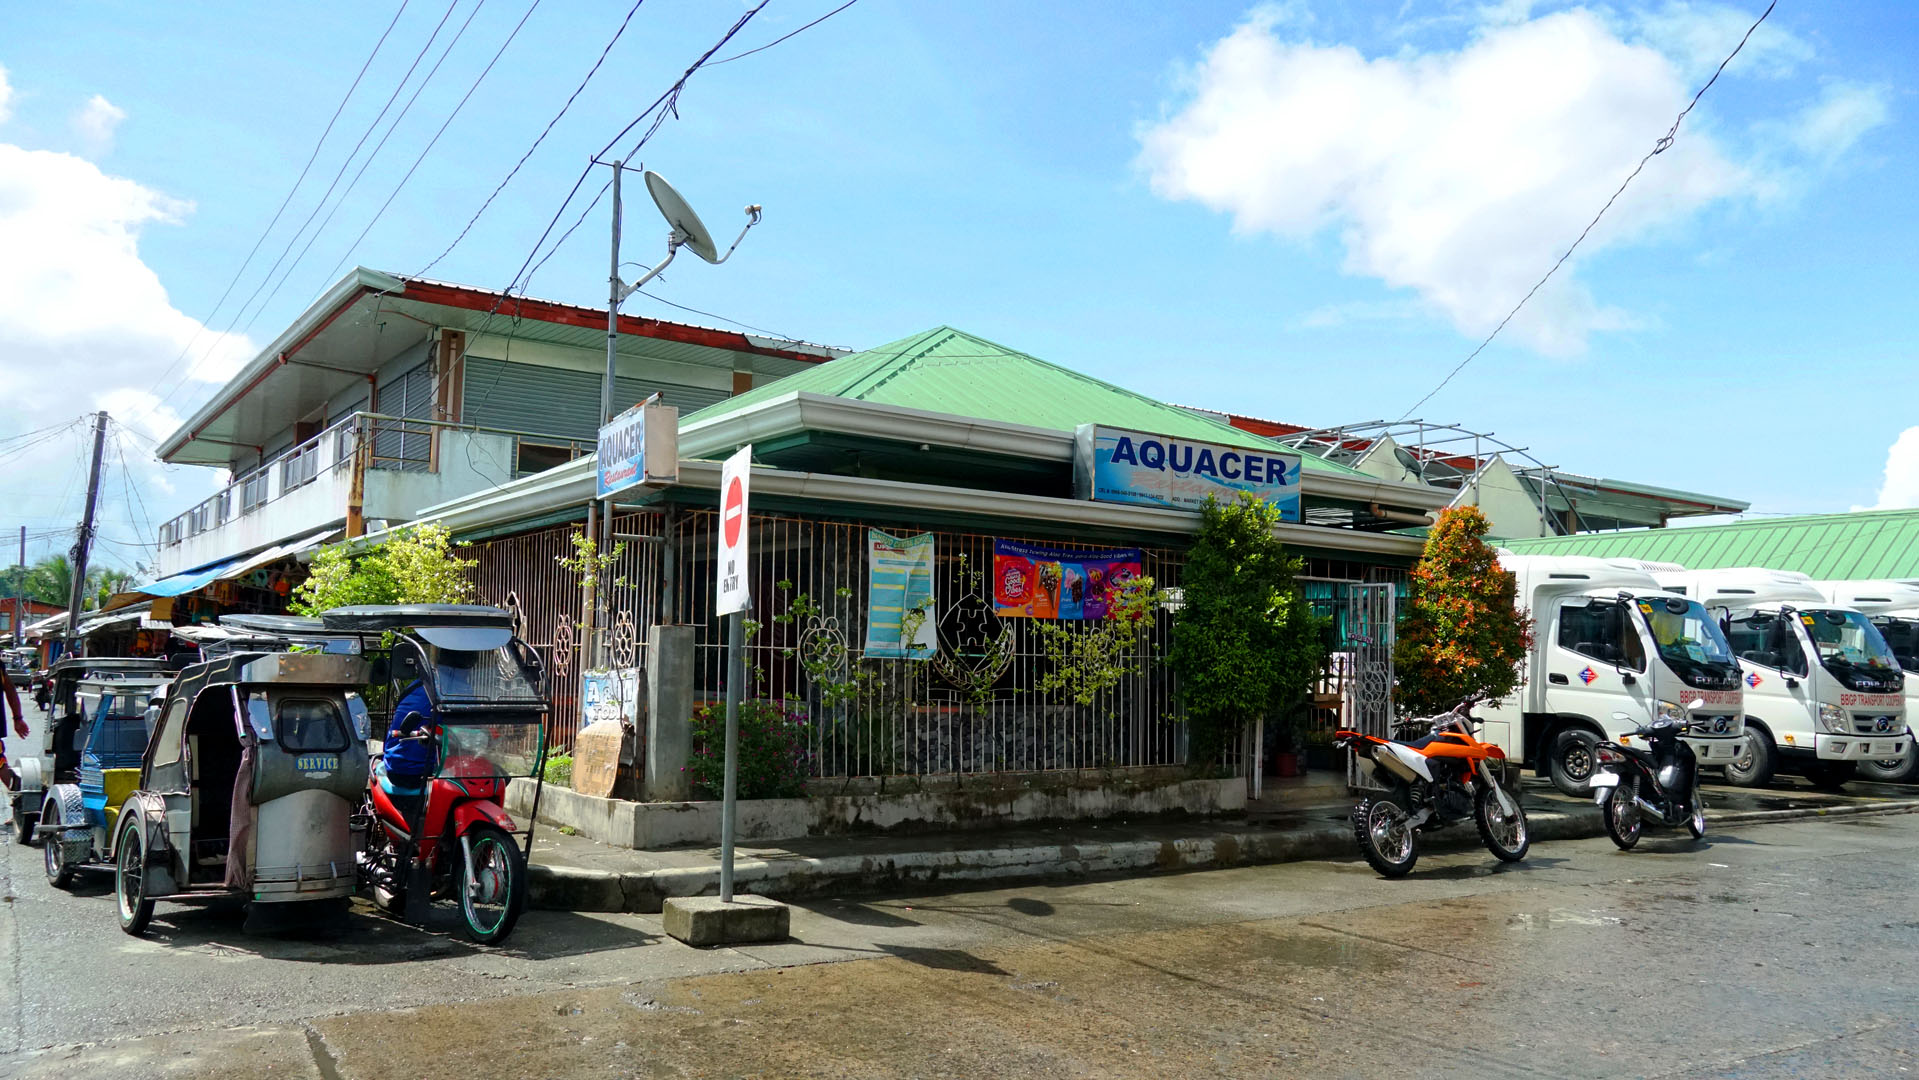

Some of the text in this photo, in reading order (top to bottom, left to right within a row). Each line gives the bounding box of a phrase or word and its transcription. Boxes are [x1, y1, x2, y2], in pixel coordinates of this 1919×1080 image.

[600, 421, 642, 470] AQUACER
[1110, 436, 1288, 486] AQUACER
[727, 559, 735, 576] NO
[723, 574, 739, 594] ENTRY
[1350, 633, 1373, 644] OPEN
[586, 680, 600, 703] A
[1841, 693, 1857, 706] BBGP
[1857, 694, 1884, 706] TRANSPORT
[297, 757, 339, 770] SERVICE
